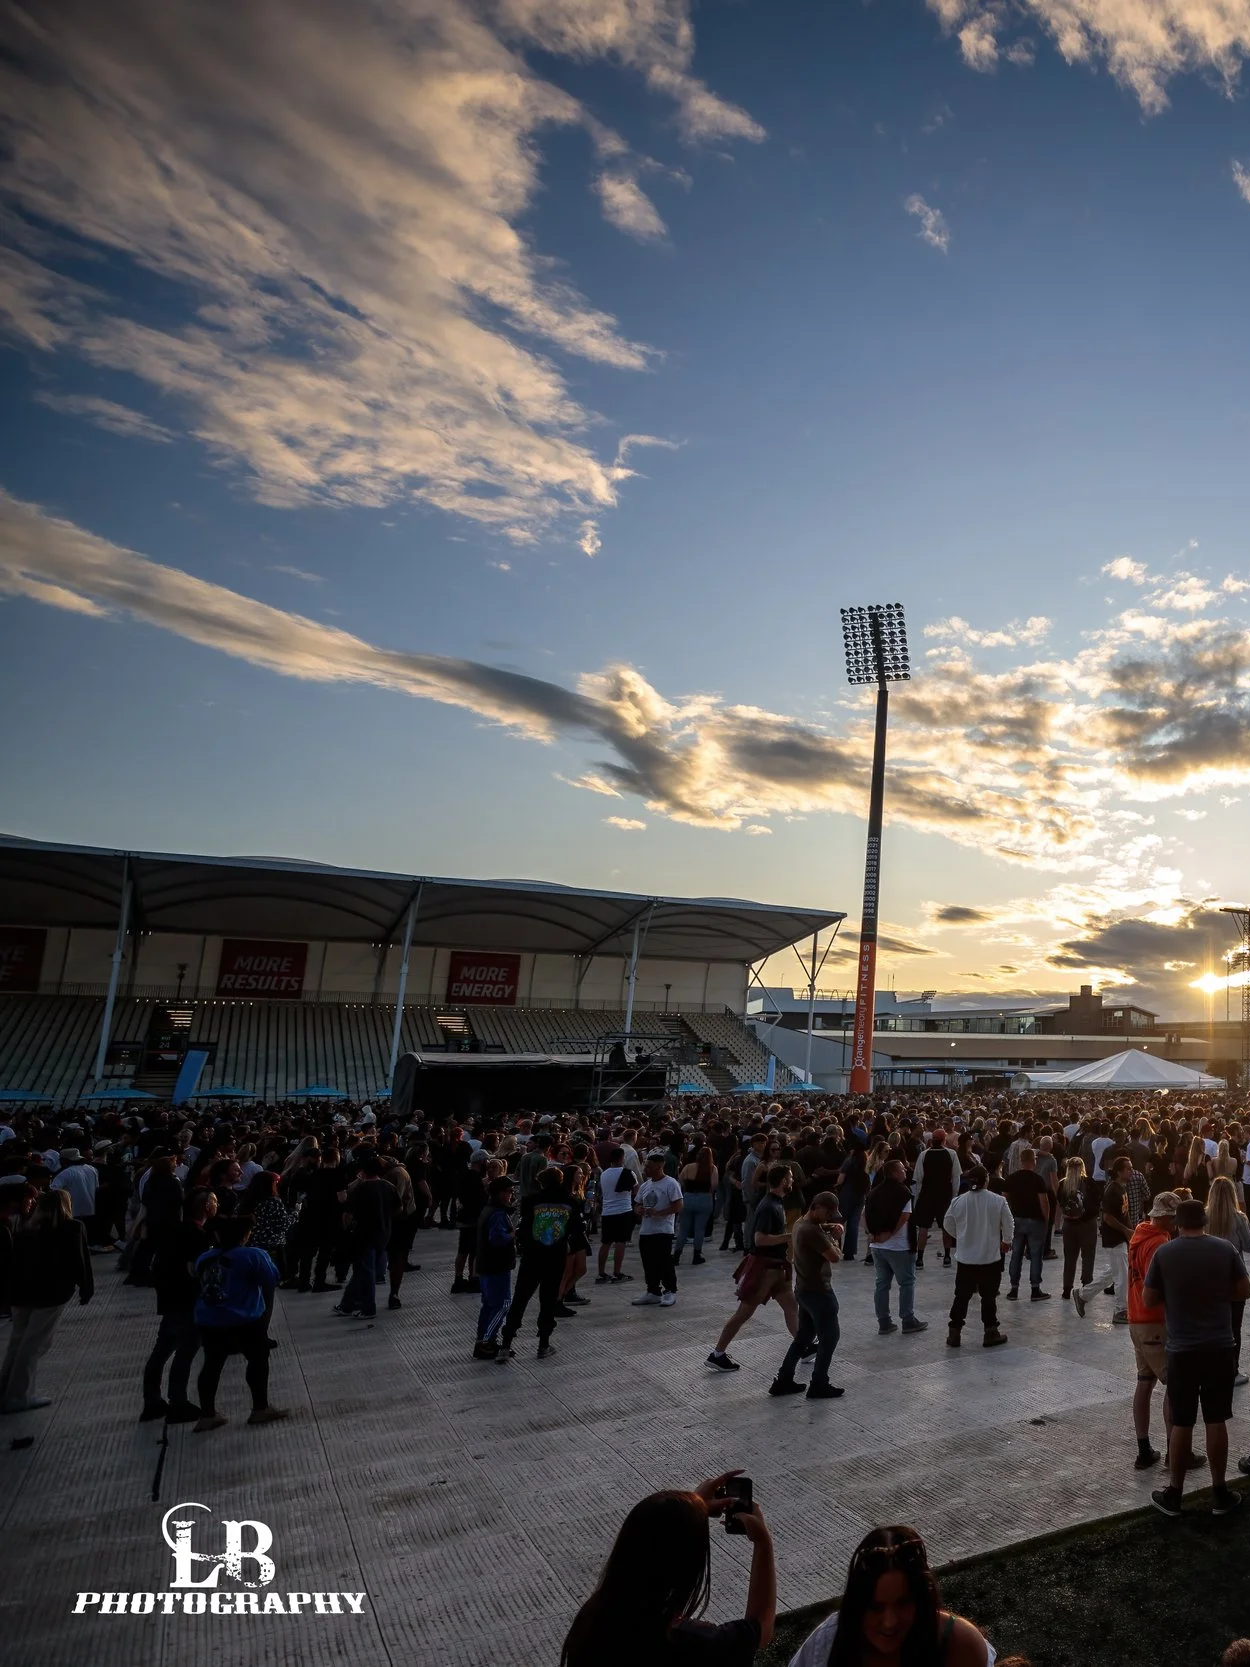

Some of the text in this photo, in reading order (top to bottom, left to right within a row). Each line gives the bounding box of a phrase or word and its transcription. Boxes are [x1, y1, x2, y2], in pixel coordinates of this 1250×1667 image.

[233, 955, 294, 973] MORE
[460, 966, 509, 981] MORE
[860, 944, 870, 1005] FITNESS
[220, 974, 302, 992] RESULTS
[451, 983, 515, 998] ENERGY
